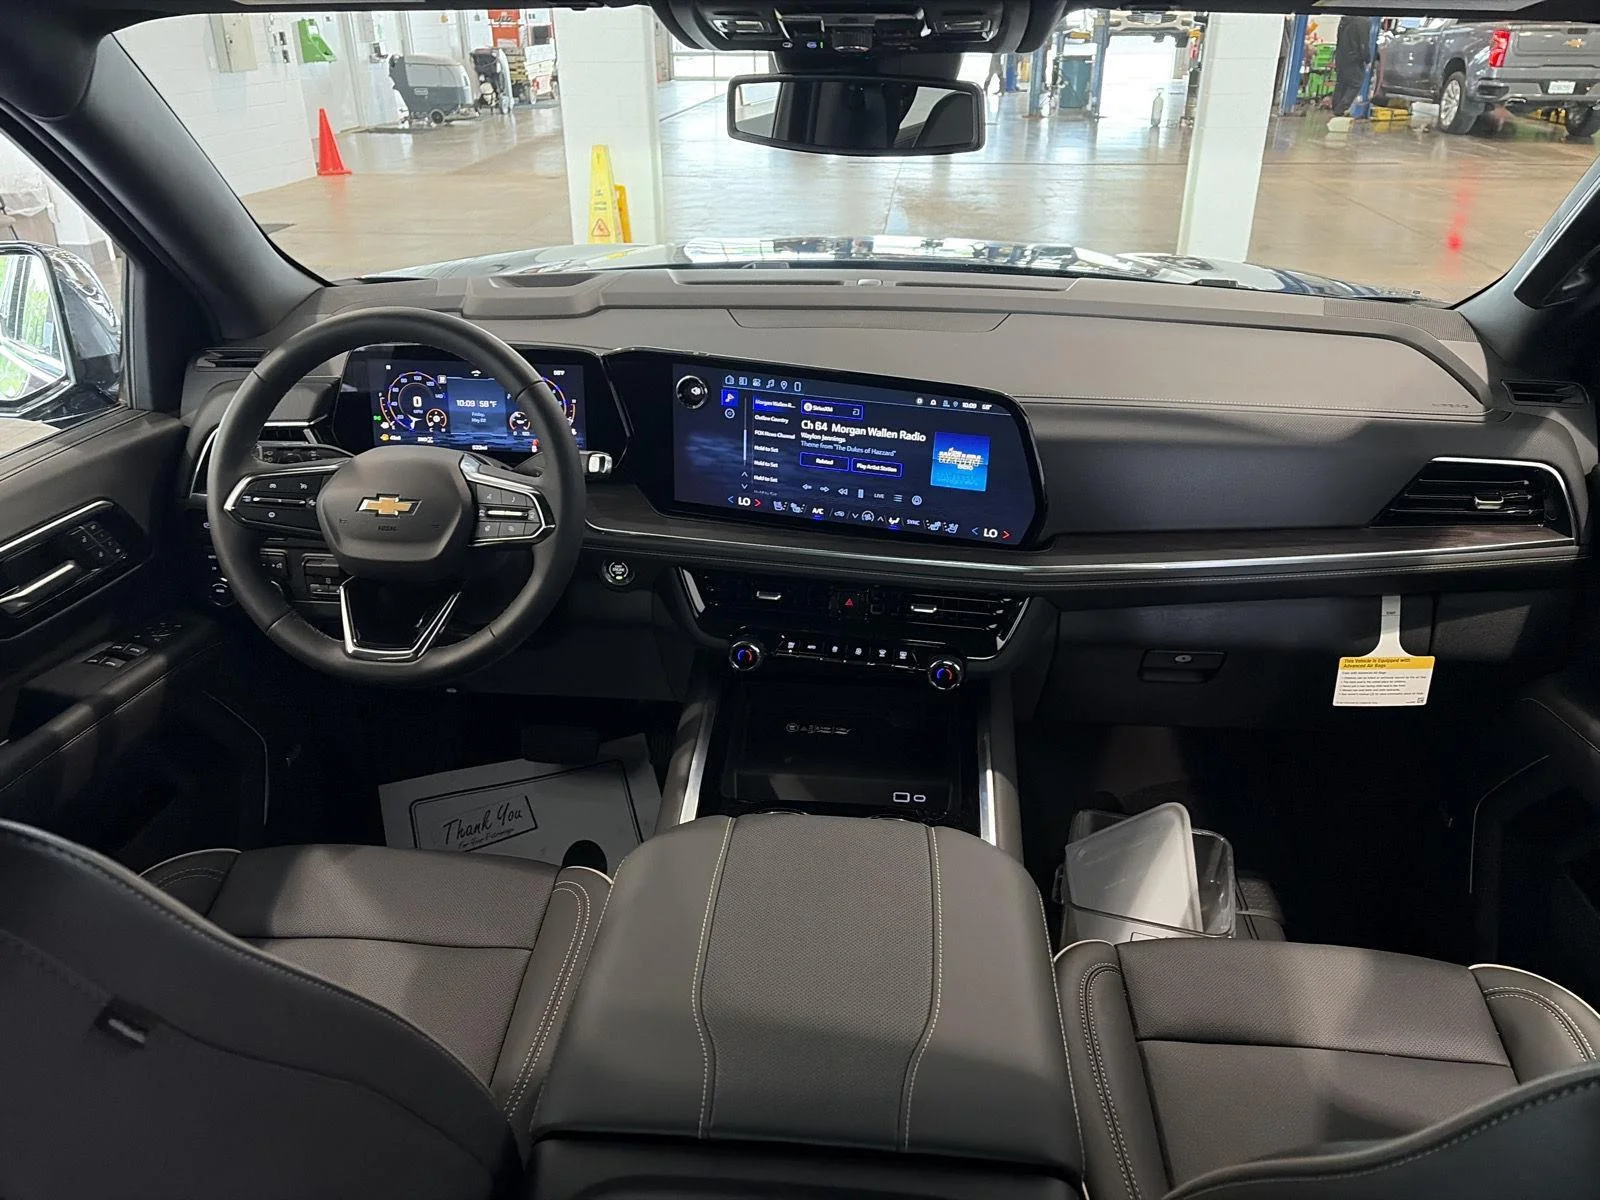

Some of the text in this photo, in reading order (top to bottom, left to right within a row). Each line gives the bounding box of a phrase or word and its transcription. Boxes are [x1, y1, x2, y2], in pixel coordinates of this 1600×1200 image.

[771, 416, 789, 424] Country
[801, 420, 813, 430] Ch
[832, 423, 866, 437] Morgan
[867, 427, 898, 439] Wallen
[900, 430, 926, 442] Radio
[801, 432, 846, 443] Waylon Jennings
[738, 496, 751, 506] LO
[984, 528, 998, 538] LO
[443, 802, 523, 845] Thank You
